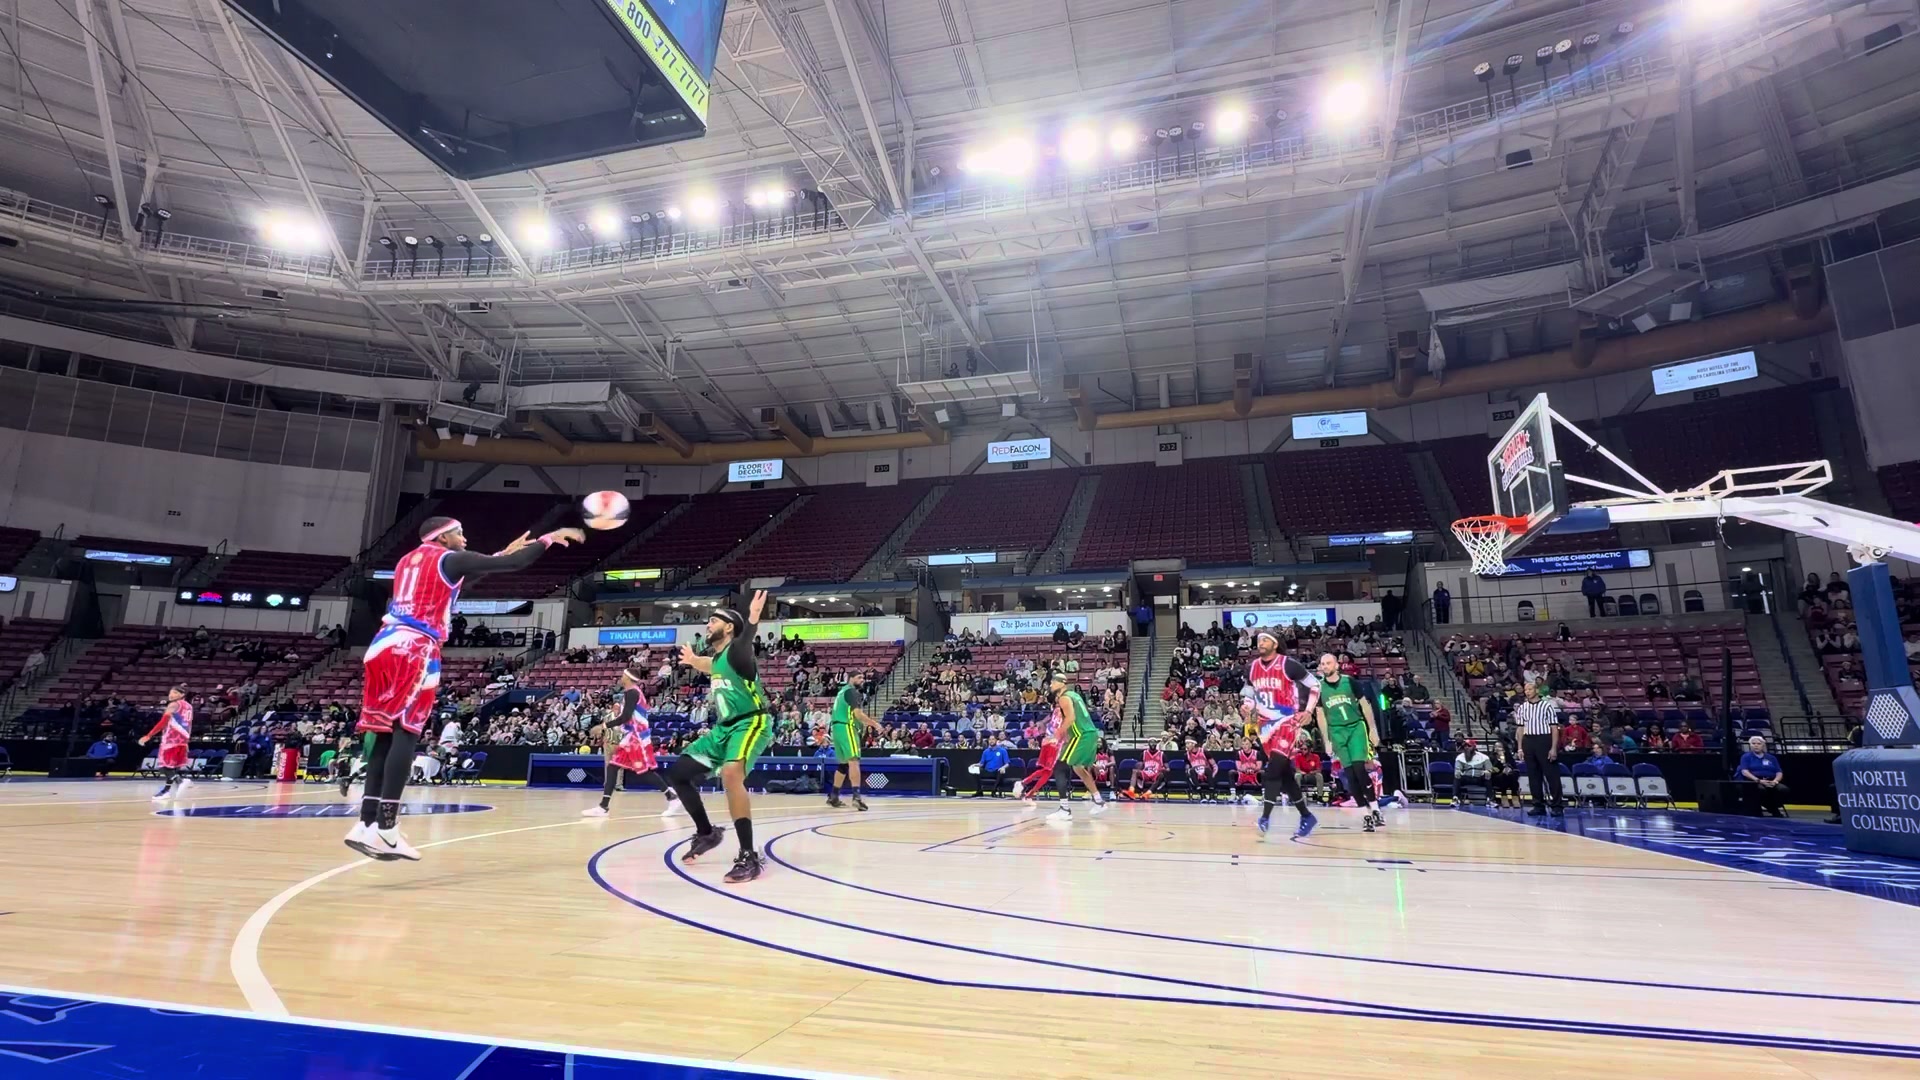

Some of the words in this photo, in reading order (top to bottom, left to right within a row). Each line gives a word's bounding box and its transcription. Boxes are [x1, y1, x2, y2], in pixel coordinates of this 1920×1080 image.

[626, 2, 706, 105] 800-777-7777
[1703, 370, 1725, 378] CAROLINA
[1545, 555, 1569, 563] BRIDGE
[1570, 551, 1622, 561] CHIROPRACTIC
[396, 567, 420, 602] 11
[1000, 620, 1014, 629] The
[1014, 620, 1030, 630] Post
[1031, 619, 1045, 628] and
[610, 632, 640, 640] TIKKUN
[1259, 691, 1275, 708] 31
[1338, 706, 1348, 721] 1
[1851, 770, 1908, 787] NORTH
[1838, 792, 1920, 811] CHARLESTO
